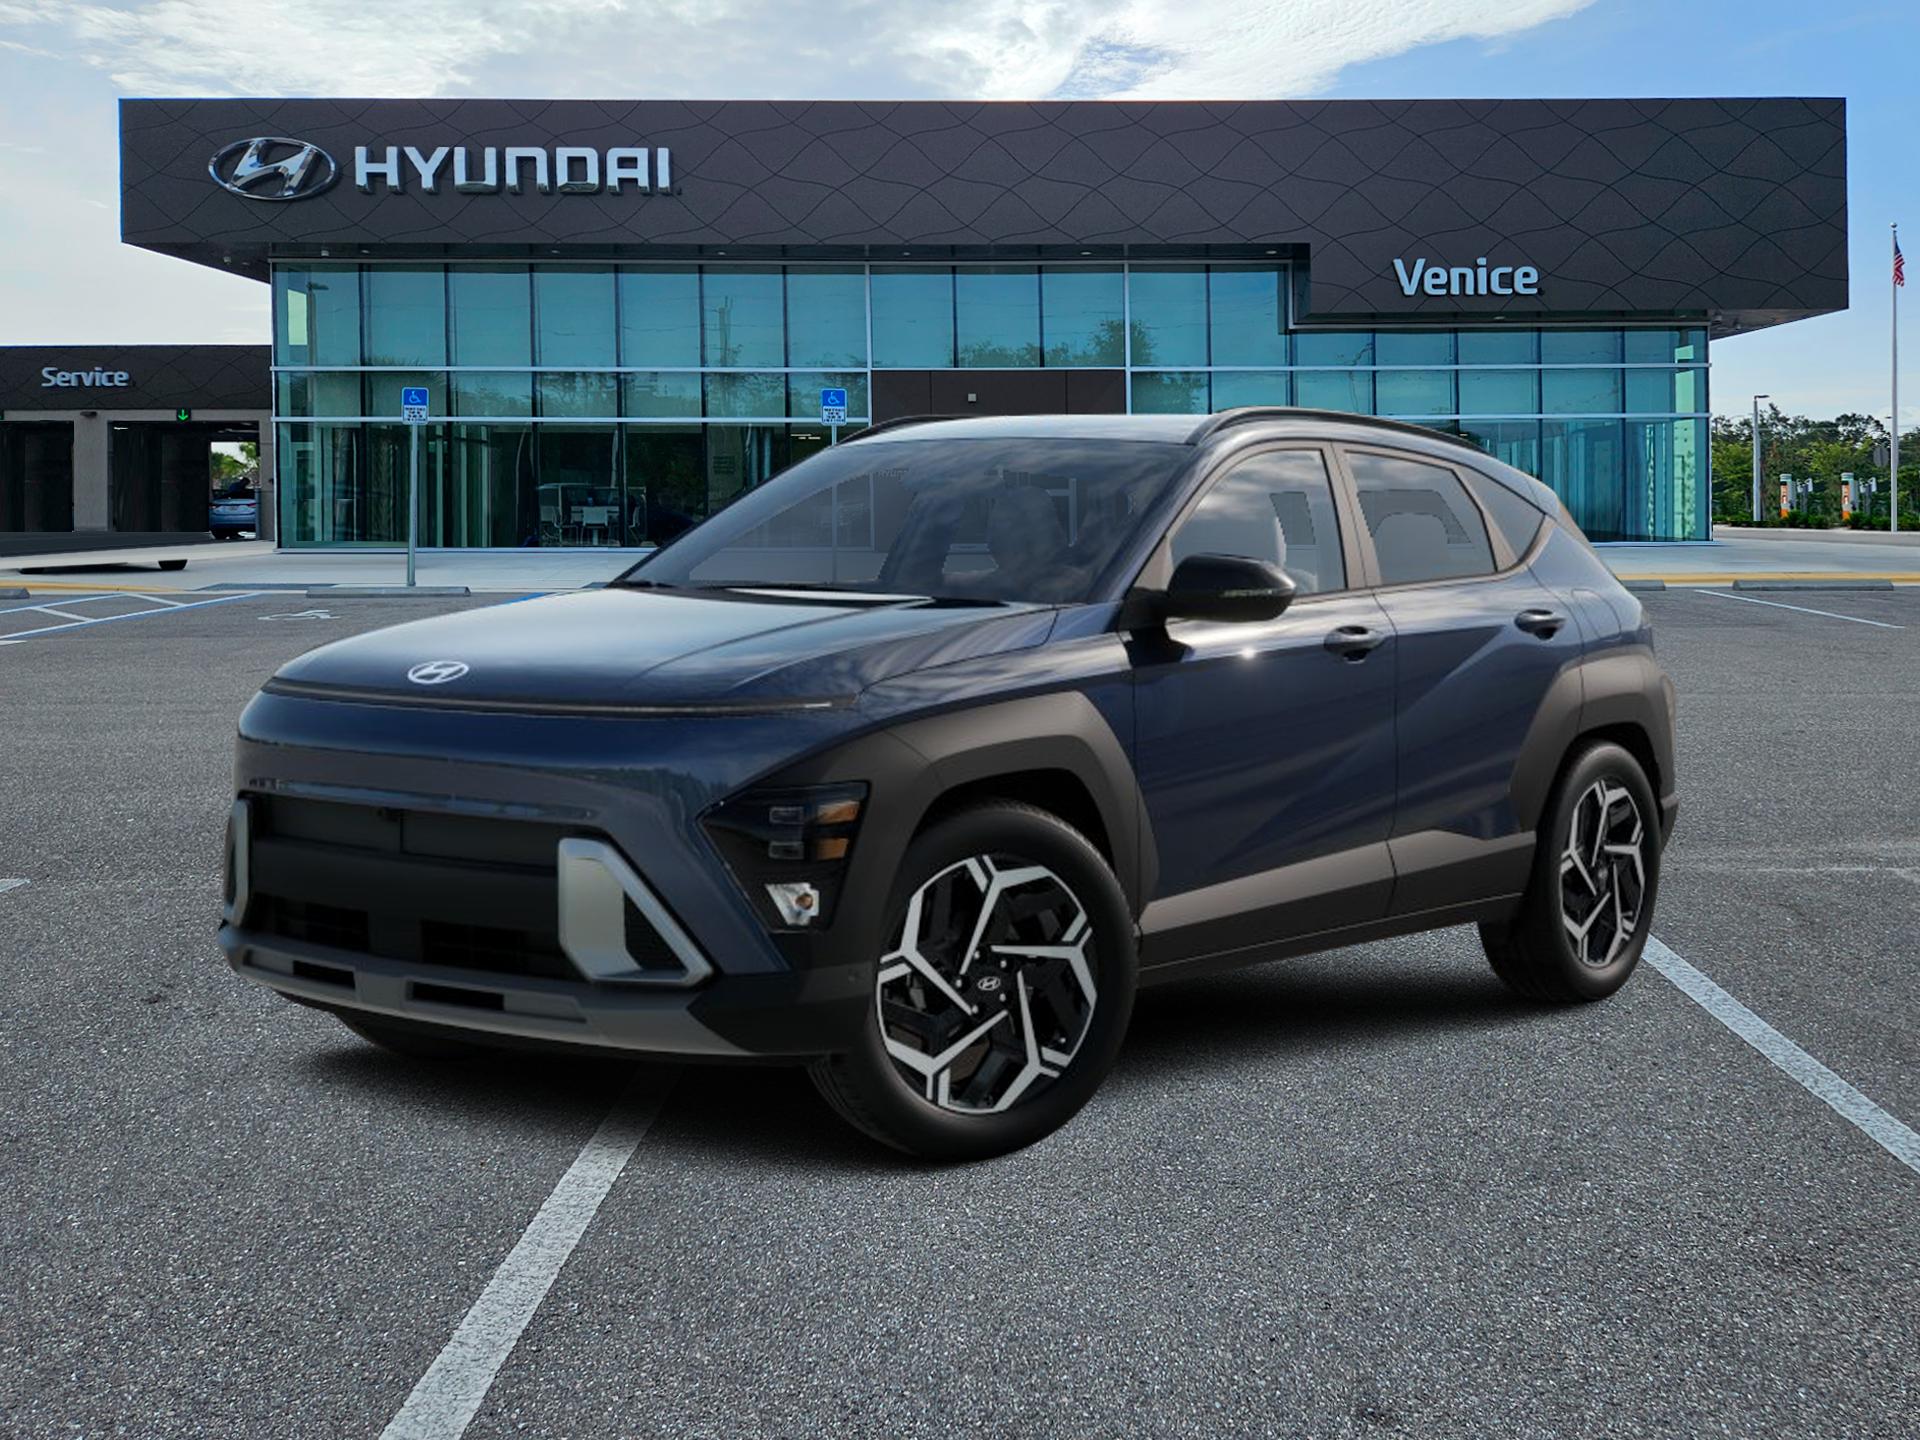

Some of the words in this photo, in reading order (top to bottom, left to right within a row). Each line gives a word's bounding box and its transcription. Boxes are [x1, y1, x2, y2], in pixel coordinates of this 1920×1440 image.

[354, 146, 671, 193] HYUNDAI
[1393, 257, 1539, 296] Venice
[41, 366, 129, 387] Service
